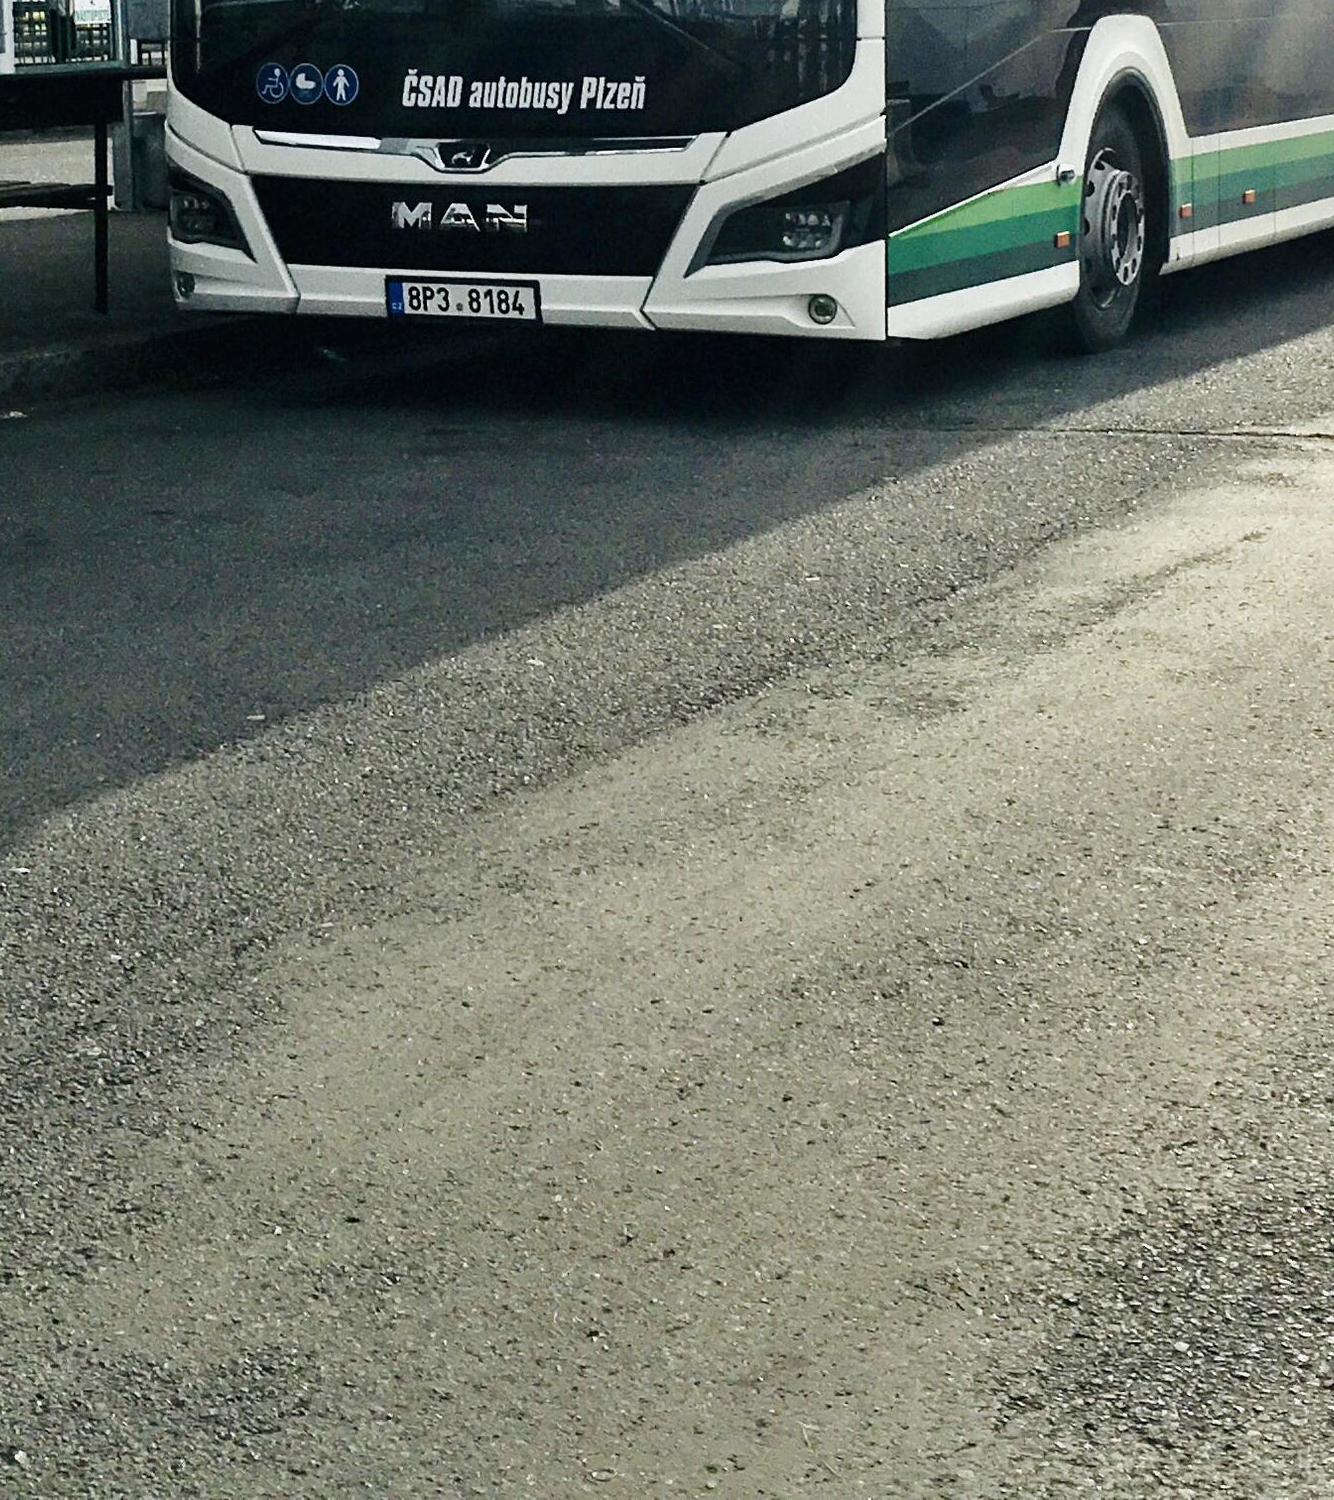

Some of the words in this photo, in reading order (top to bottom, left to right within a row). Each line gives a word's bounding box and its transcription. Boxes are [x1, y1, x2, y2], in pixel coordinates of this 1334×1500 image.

[402, 69, 464, 108] ČSAD
[469, 76, 574, 115] autobusy
[580, 75, 647, 109] Plzeň
[391, 201, 528, 233] MAN
[407, 286, 450, 312] 8P3
[467, 288, 525, 316] 8184
